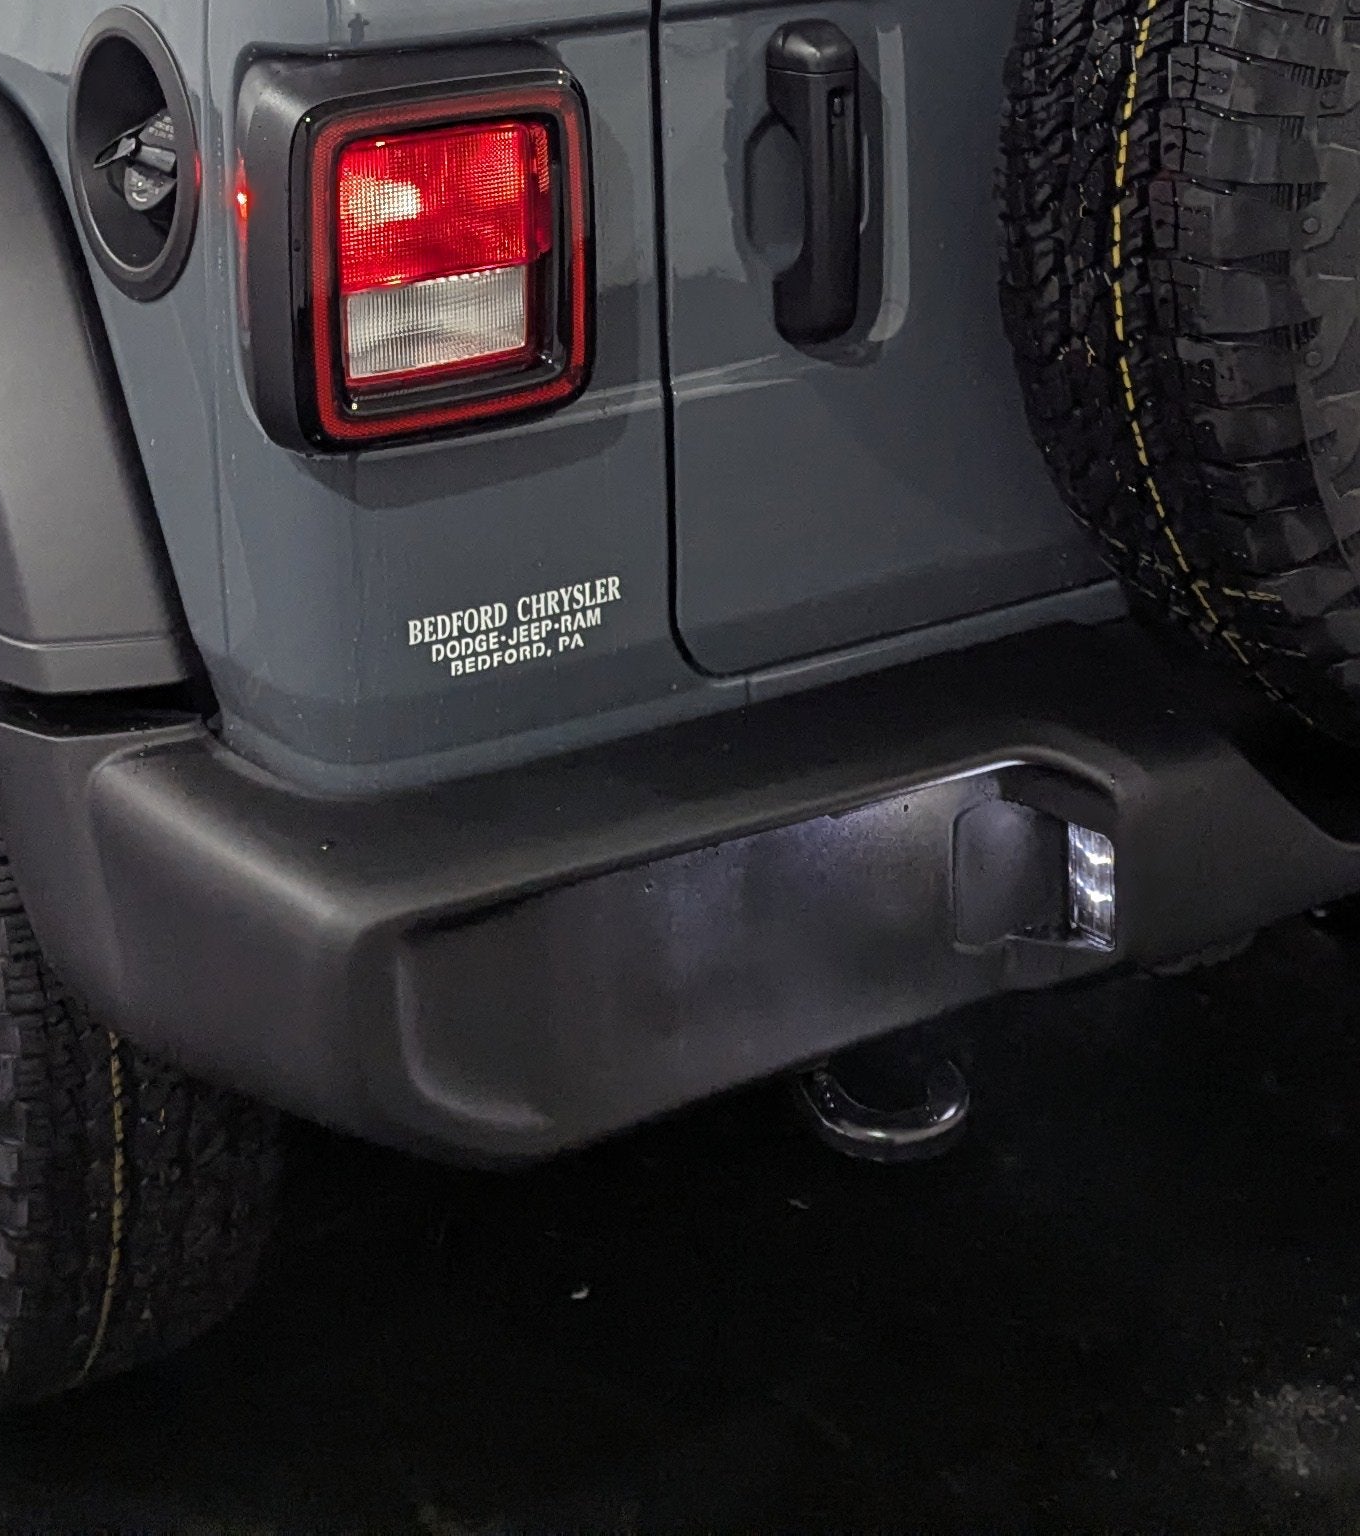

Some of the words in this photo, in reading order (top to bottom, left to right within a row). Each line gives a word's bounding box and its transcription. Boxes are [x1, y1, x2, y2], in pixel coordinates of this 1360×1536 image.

[407, 602, 508, 646] BEDFORD
[517, 575, 622, 623] CHRYSLER
[450, 641, 553, 677] BEDFORD,
[557, 633, 585, 654] PA
